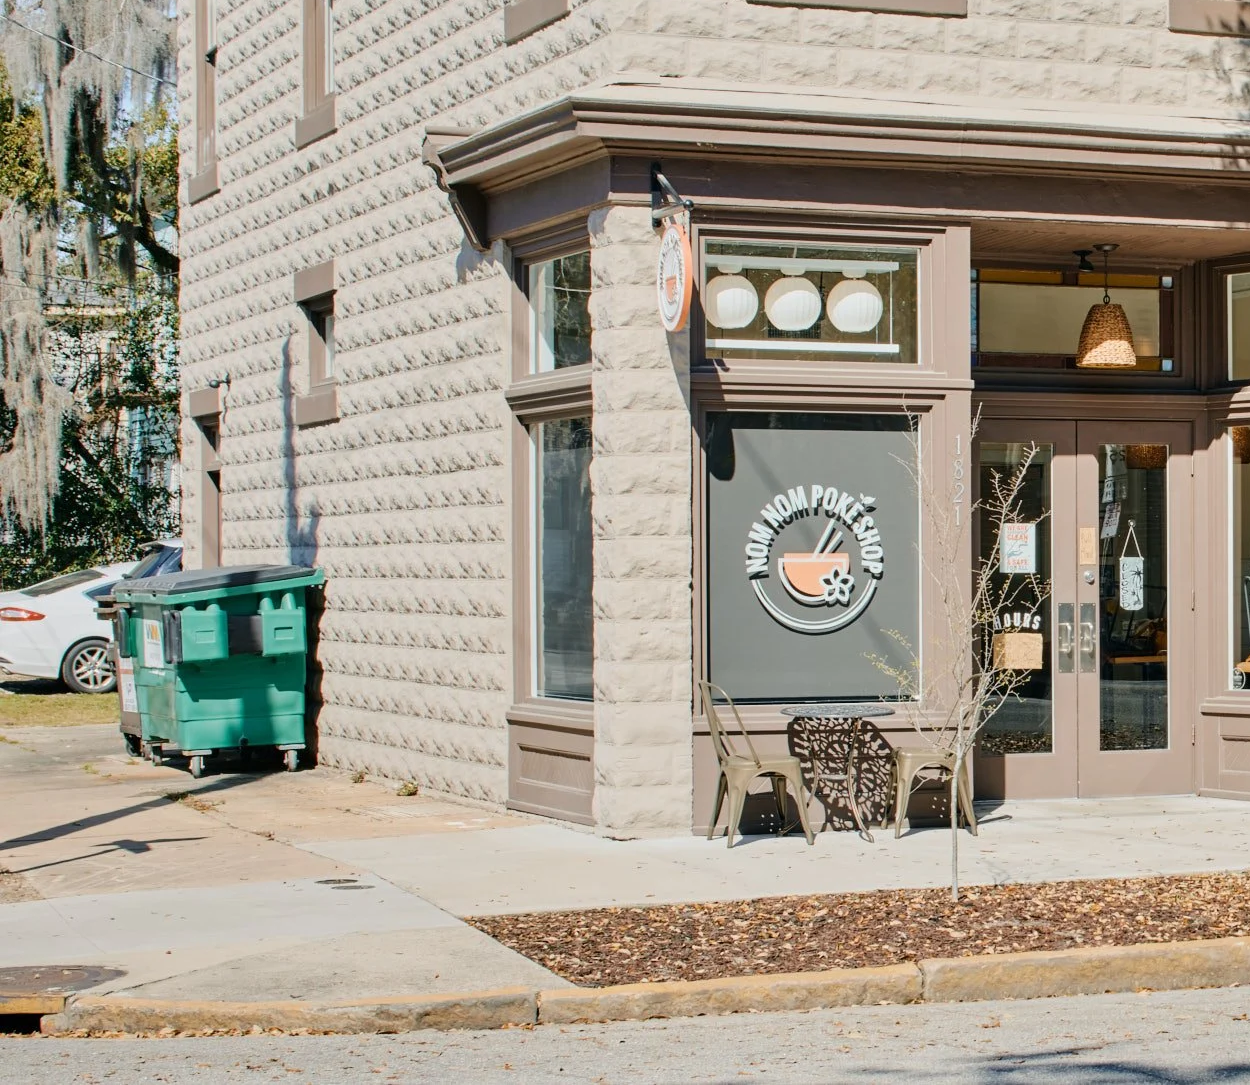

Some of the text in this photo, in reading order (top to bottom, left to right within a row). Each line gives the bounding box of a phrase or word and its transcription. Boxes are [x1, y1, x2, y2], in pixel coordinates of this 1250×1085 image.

[953, 434, 964, 526] 1821
[745, 521, 773, 574] NOM
[760, 485, 809, 528] NOM
[852, 515, 884, 575] SHOP
[1121, 563, 1130, 608] CLOSED
[994, 612, 1041, 630] HOURS
